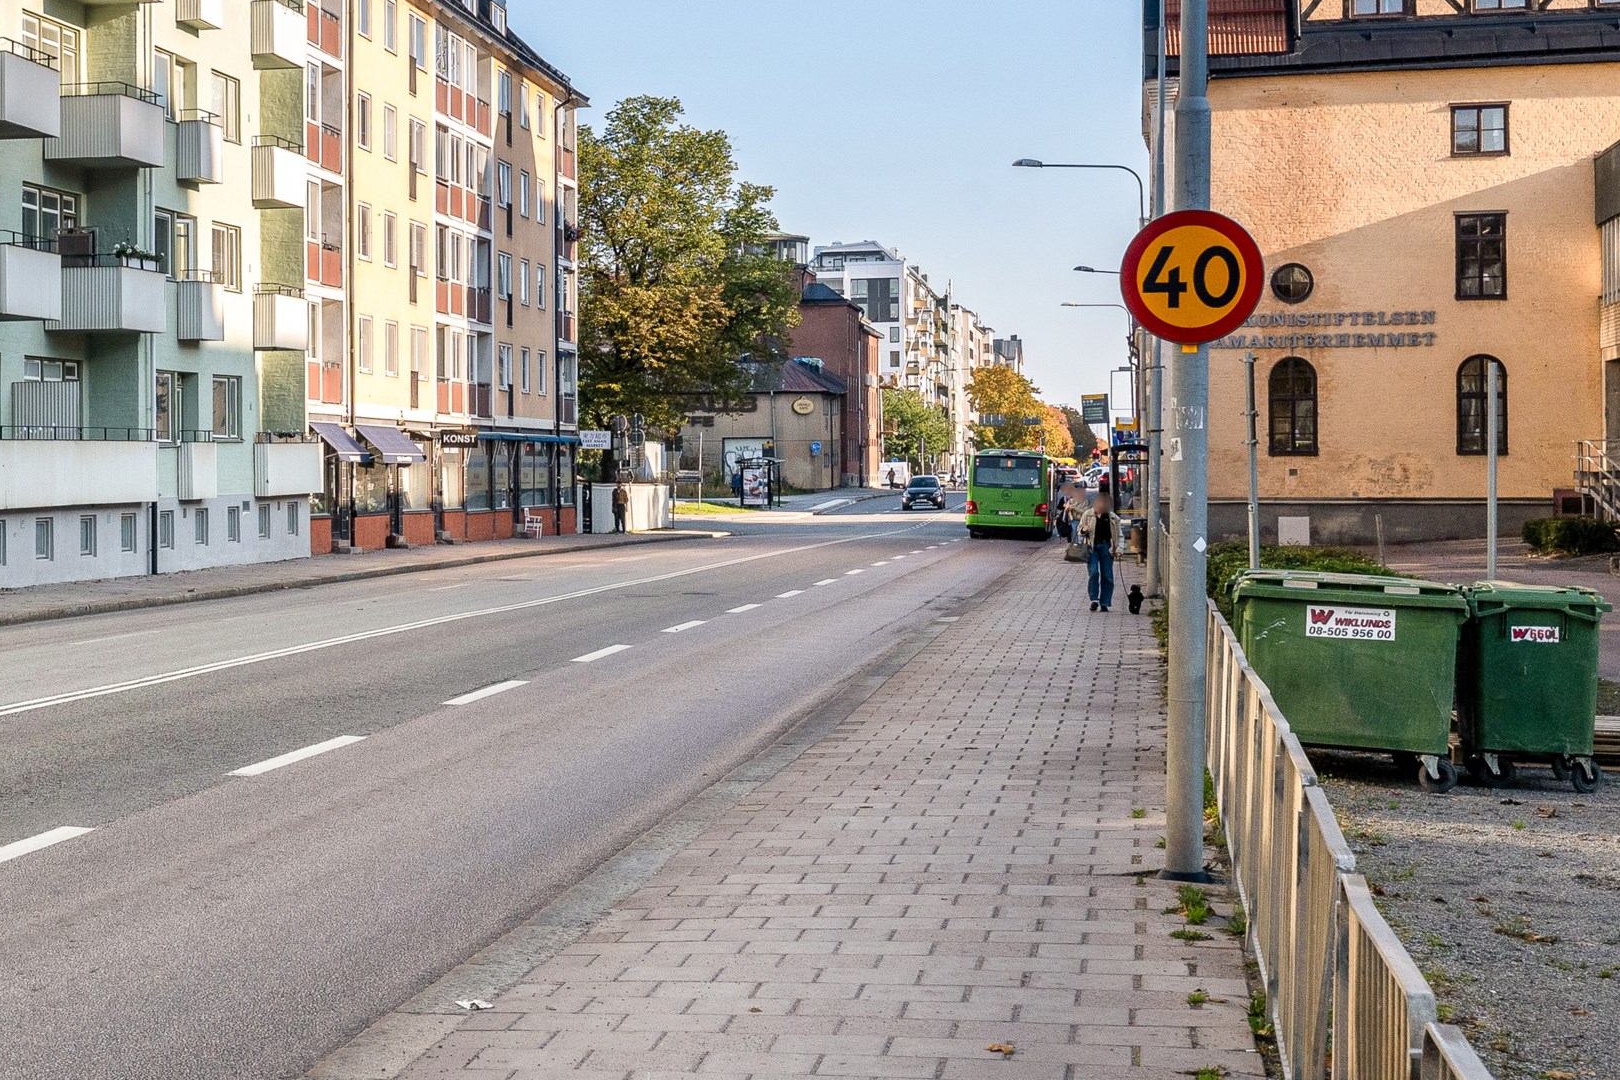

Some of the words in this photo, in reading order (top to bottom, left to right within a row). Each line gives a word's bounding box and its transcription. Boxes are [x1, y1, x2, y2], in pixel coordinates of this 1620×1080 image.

[1142, 245, 1240, 308] 40
[1241, 311, 1436, 328] KONISTIFTELSEN
[1210, 332, 1436, 349] AMARITERHEMMET
[443, 434, 476, 443] KONST
[1335, 617, 1392, 628] WIKLUNDS
[1309, 626, 1348, 637] 08-505
[1352, 628, 1374, 638] 956
[1377, 630, 1392, 639] 00
